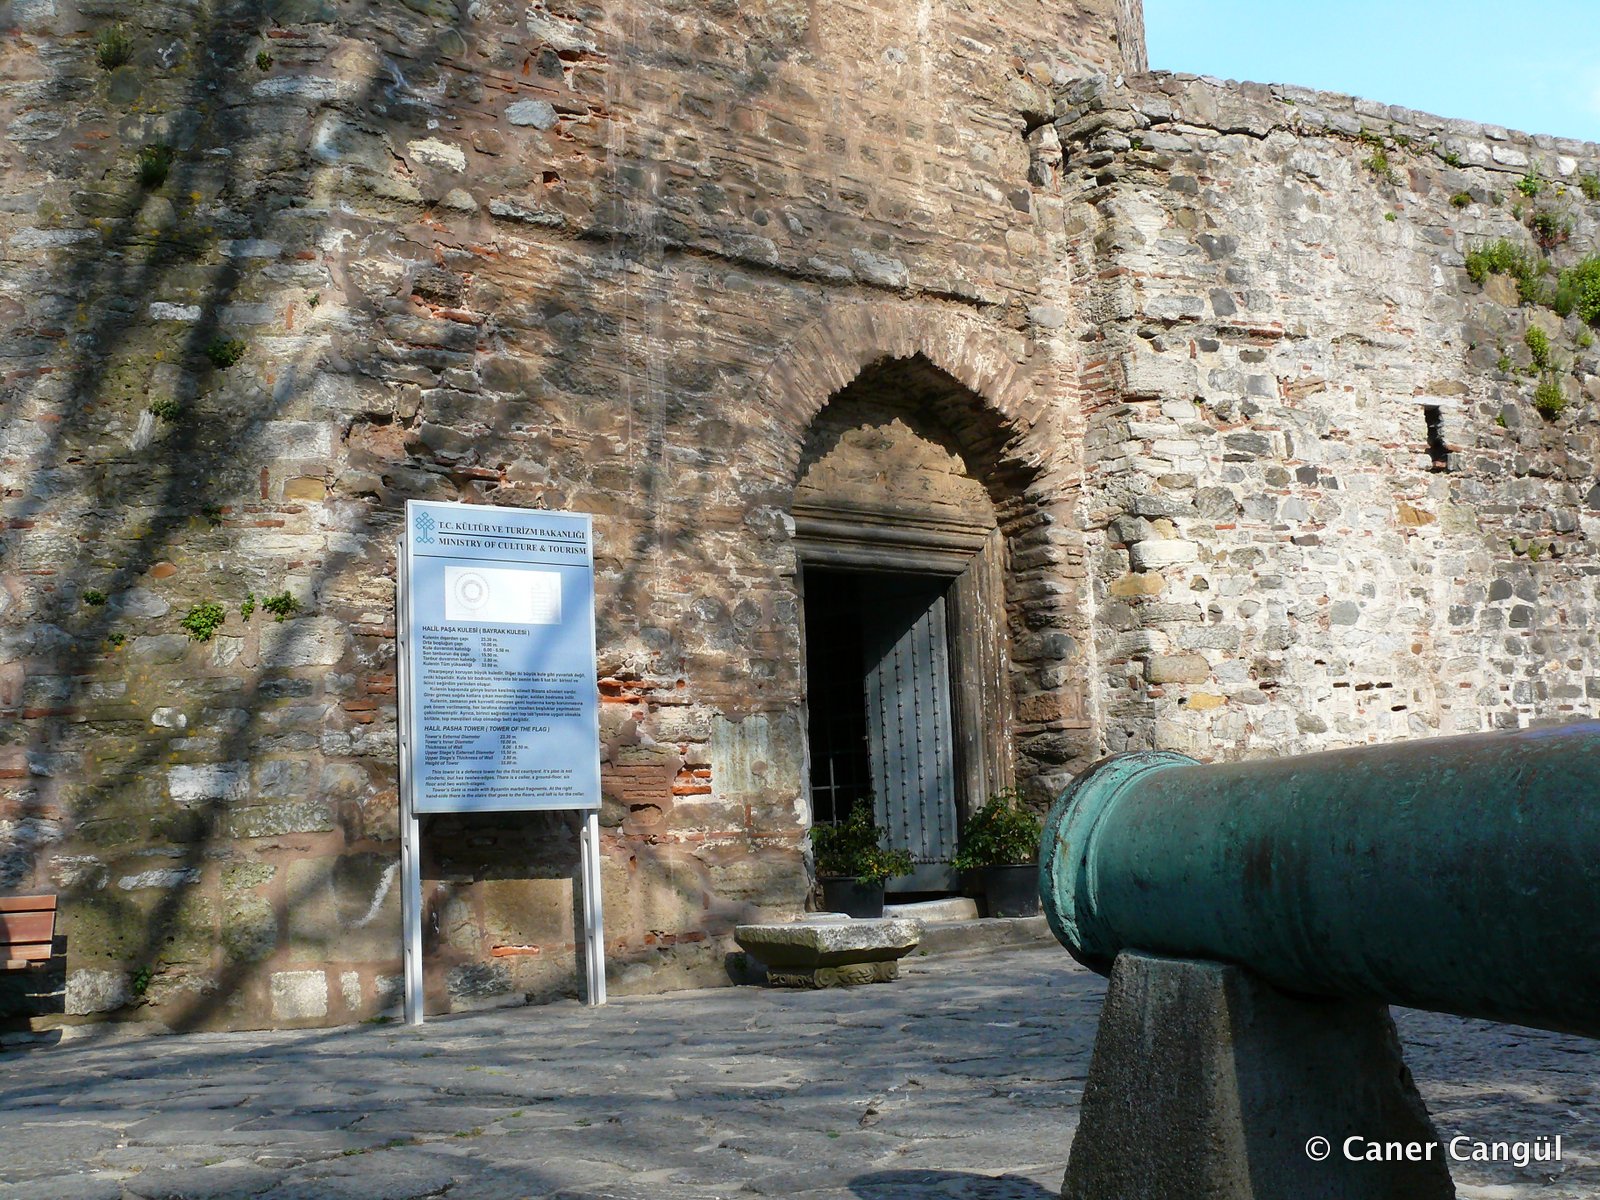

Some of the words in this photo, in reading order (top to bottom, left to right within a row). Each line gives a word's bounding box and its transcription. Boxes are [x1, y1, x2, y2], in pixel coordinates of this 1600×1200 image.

[439, 521, 453, 530] T.C.
[455, 521, 490, 532] KÜLTÜR
[491, 525, 503, 533] VE
[505, 525, 537, 535] TURİZM
[539, 528, 585, 539] BAKANLIĞI
[438, 537, 481, 548] MINISTRY
[498, 541, 538, 552] CULTURE
[548, 545, 586, 555] TOURISM
